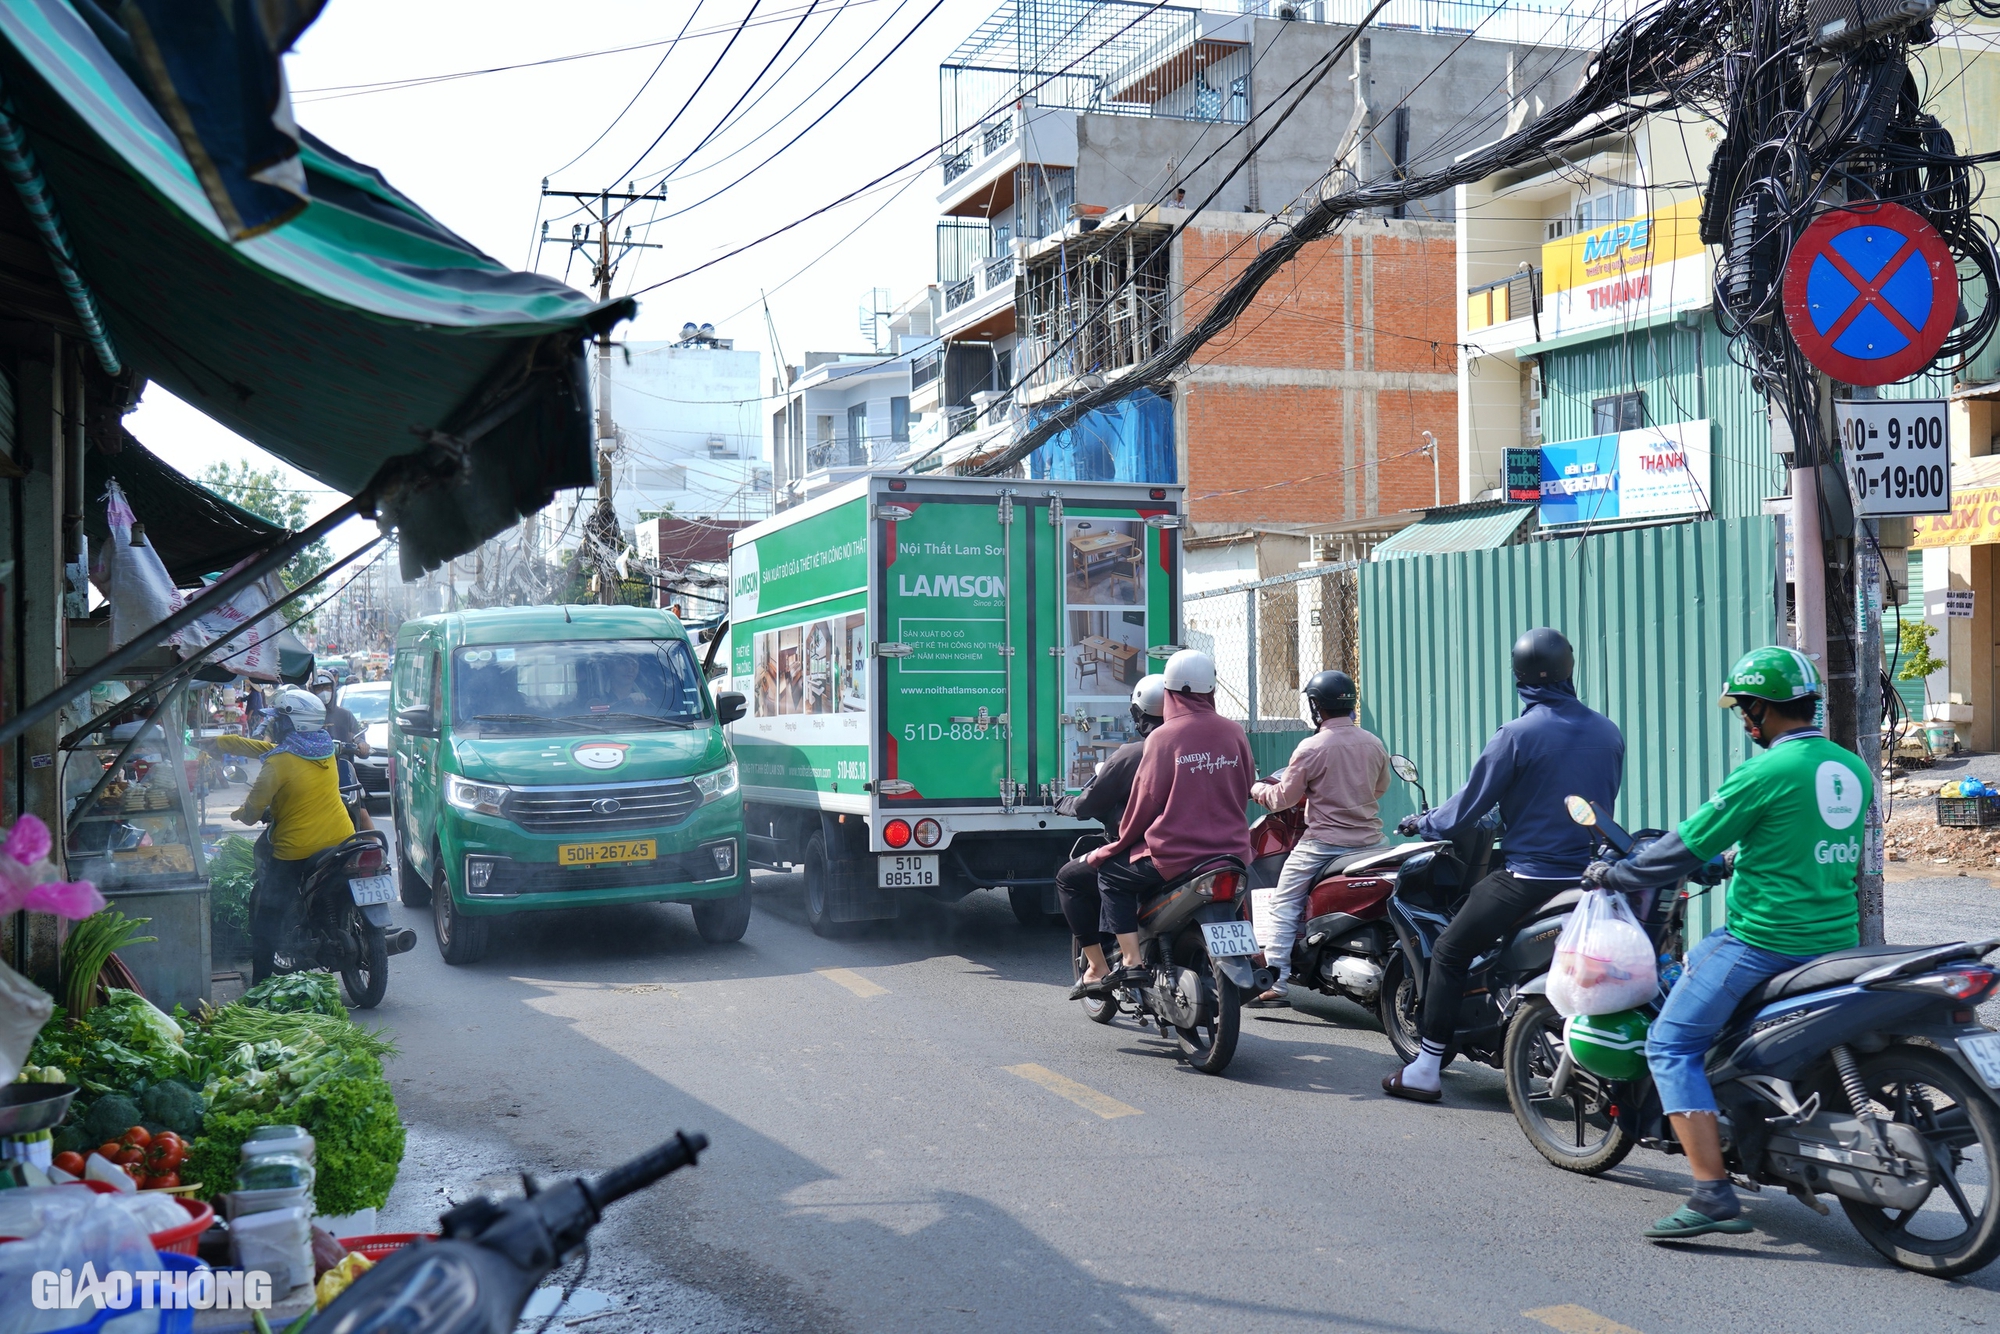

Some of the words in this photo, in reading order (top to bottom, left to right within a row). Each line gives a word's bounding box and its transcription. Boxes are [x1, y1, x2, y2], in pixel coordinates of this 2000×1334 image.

[1583, 219, 1654, 263] MPE
[1587, 275, 1650, 310] THẠNH
[1509, 451, 1538, 470] TIỆM
[1639, 451, 1684, 473] THẠNH
[1509, 470, 1539, 489] ĐIỆN
[900, 542, 921, 556] Nội
[924, 541, 952, 555] Thất
[955, 544, 981, 555] Lam
[937, 641, 949, 649] THI
[950, 641, 972, 649] CÔNG
[1734, 671, 1766, 686] Grab
[1175, 751, 1211, 767] SOMEDAY
[838, 760, 866, 780] 51D-885.18
[566, 843, 649, 862] 50H-267.45
[1814, 836, 1860, 864] Grab
[895, 856, 922, 871] 51D
[355, 876, 386, 892] 54-S1
[885, 871, 933, 886] 885.18
[359, 889, 391, 903] 7796
[1211, 924, 1248, 939] 82-B2
[1211, 939, 1255, 955] 020.41
